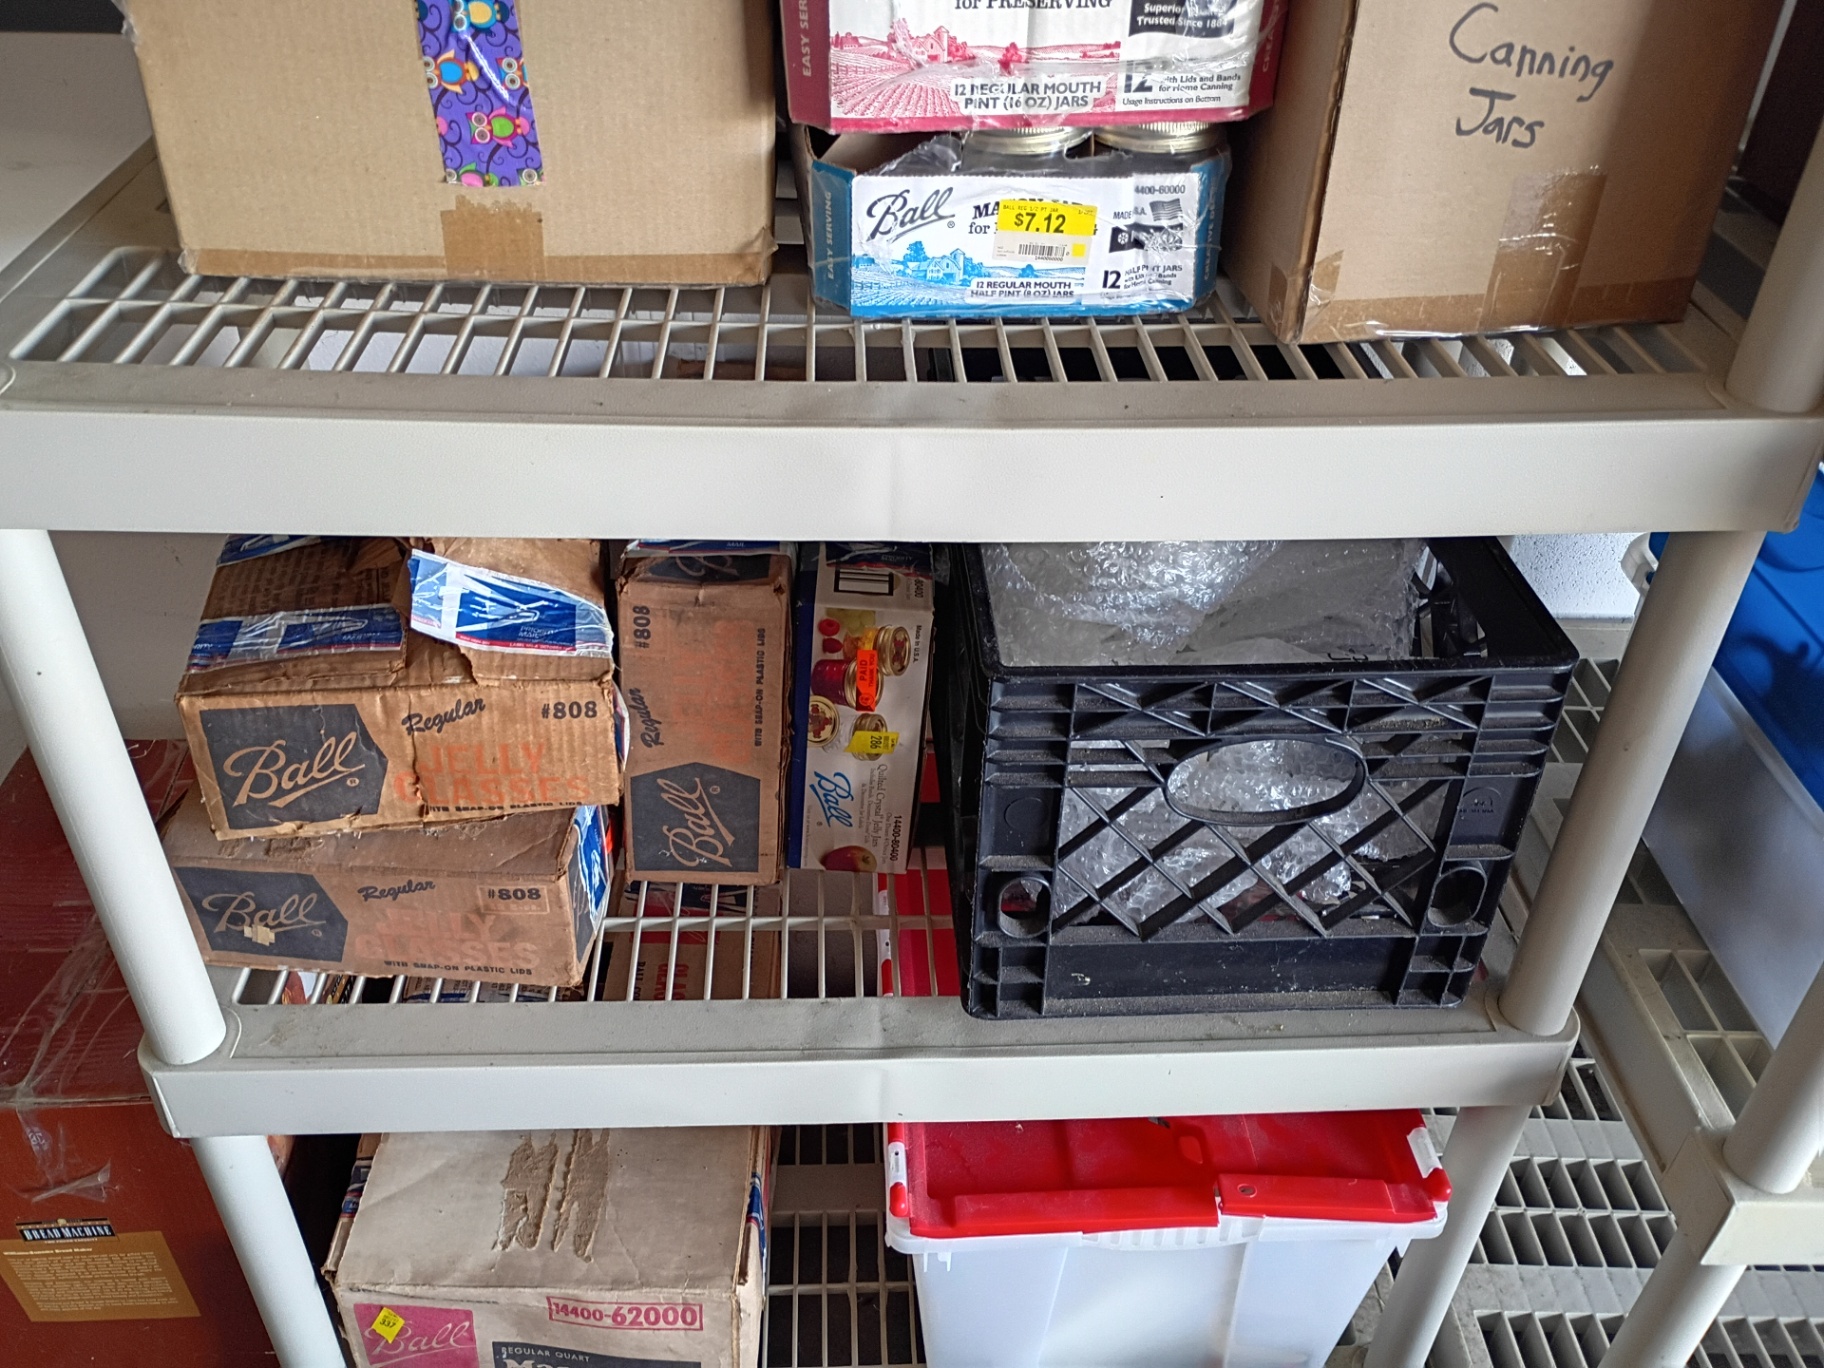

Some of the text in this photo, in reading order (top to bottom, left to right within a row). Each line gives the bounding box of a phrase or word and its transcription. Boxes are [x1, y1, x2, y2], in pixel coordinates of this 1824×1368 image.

[1136, 16, 1175, 26] Trusted
[1177, 17, 1203, 28] Since
[800, 43, 812, 77] EASY
[1449, 1, 1614, 103] Canning
[954, 83, 967, 96] 12
[1043, 81, 1101, 95] MOUTH
[1180, 74, 1197, 84] Lids
[1199, 74, 1214, 83] and
[1217, 73, 1241, 82] Bands
[1200, 82, 1233, 93] Canning
[964, 97, 1000, 110] PINT
[1054, 95, 1089, 109] JARS
[1122, 97, 1143, 106] Usage
[1455, 87, 1545, 149] Jars
[866, 186, 956, 244] Ball
[1014, 212, 1067, 234] $7.12
[825, 191, 835, 280] EASY SERVING
[968, 221, 991, 234] for
[1102, 269, 1121, 289] 12
[1163, 264, 1183, 273] JARS
[976, 281, 1071, 289] 12 REGULAR MOUTH
[998, 290, 1024, 298] PINT
[632, 604, 651, 650] #808
[914, 624, 923, 640] Made
[755, 649, 765, 685] PLASTIC
[859, 659, 868, 682] PAID
[401, 697, 598, 736] Regular #808
[628, 687, 664, 750] Regular
[869, 735, 883, 750] 286
[222, 731, 365, 808] Ball
[418, 742, 545, 775] JELLY
[393, 769, 591, 806] GLASSES
[877, 763, 888, 791] Quilted
[809, 770, 855, 828] Ball
[656, 776, 736, 869] Ball
[872, 819, 883, 835] Jelly
[870, 835, 882, 848] Jars
[357, 879, 541, 902] Regular #808
[201, 890, 326, 934] Ball
[375, 907, 497, 941] JELLY
[355, 933, 541, 969] GLASSES
[383, 960, 533, 976] WITH SNAP-ON PLASTIC LIDS
[23, 1227, 61, 1241] BREAD
[61, 1225, 112, 1239] MACHINE
[379, 1318, 397, 1329] 337
[552, 1301, 698, 1326] 14400-62000
[501, 1346, 590, 1363] REGULAR QUART
